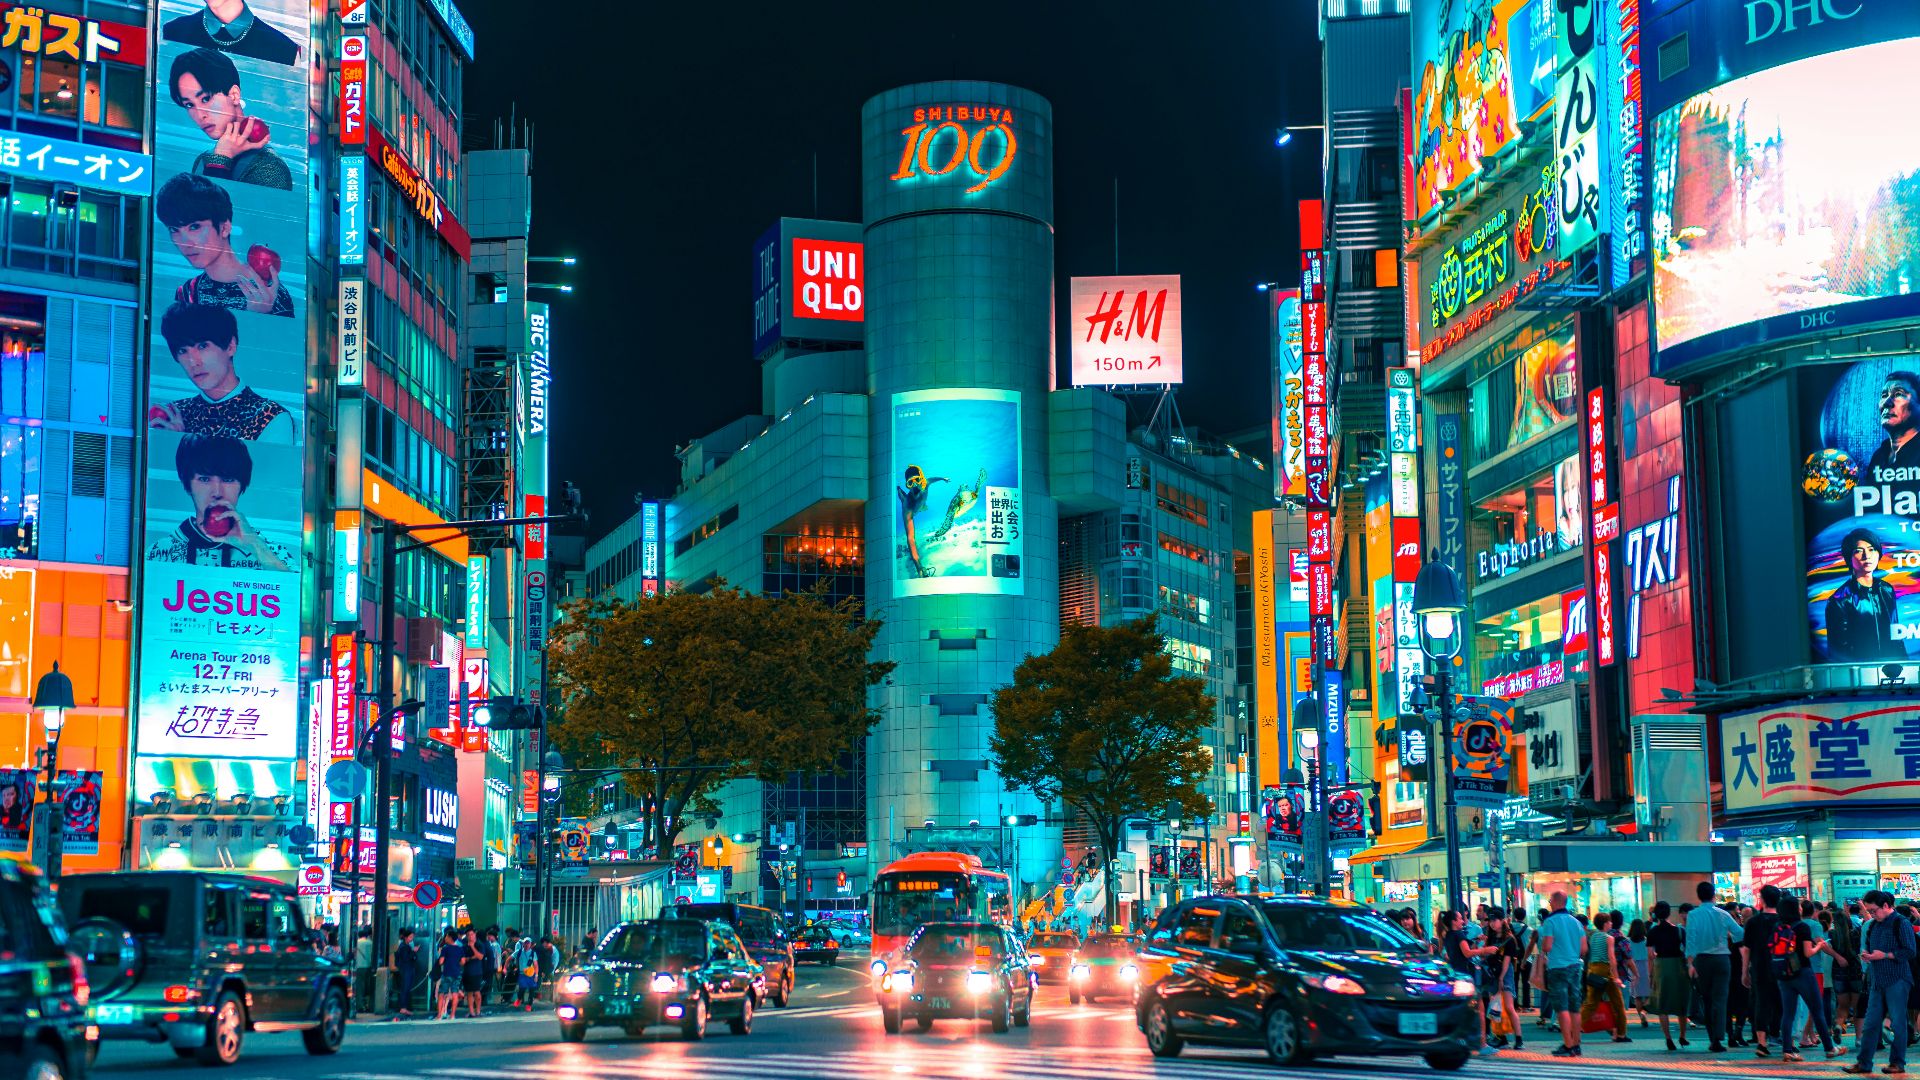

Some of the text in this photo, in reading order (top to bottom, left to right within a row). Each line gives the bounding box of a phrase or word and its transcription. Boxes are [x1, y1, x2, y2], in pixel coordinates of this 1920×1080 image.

[351, 13, 365, 22] 8F
[2, 7, 121, 63] ガスト
[346, 81, 361, 133] ガスト
[914, 107, 1014, 124] SHIBUYA
[890, 121, 1018, 194] 109
[346, 167, 359, 253] 英会話イーオン
[416, 178, 443, 231] ガスト
[802, 249, 857, 280] UNI
[802, 281, 862, 314] QLO
[344, 286, 358, 378] 渋谷駅前ビル
[531, 314, 545, 347] BIC
[1085, 289, 1168, 344] H&M
[1800, 310, 1836, 329] DHC
[1093, 356, 1143, 372] 150m
[531, 351, 552, 434] CAMERA
[990, 497, 1019, 511] 世界に
[1854, 484, 1920, 517] Pla
[1478, 528, 1554, 578] Euphoria
[162, 579, 281, 619] Jesus
[232, 581, 281, 591] NEW SINGLE
[528, 572, 545, 600] OS
[170, 649, 271, 665] Arena Tour 2018
[192, 663, 253, 682] 12.7 FRI
[159, 681, 280, 698] さいたまスーパーアリーナ
[1328, 683, 1339, 733] MIZUHO
[1406, 729, 1426, 765] HUB
[1466, 781, 1494, 791] Tik Tok
[426, 788, 459, 829] LUSH
[151, 823, 291, 839] 渋谷駅前ビル
[1740, 827, 1769, 836] TAISEIDO
